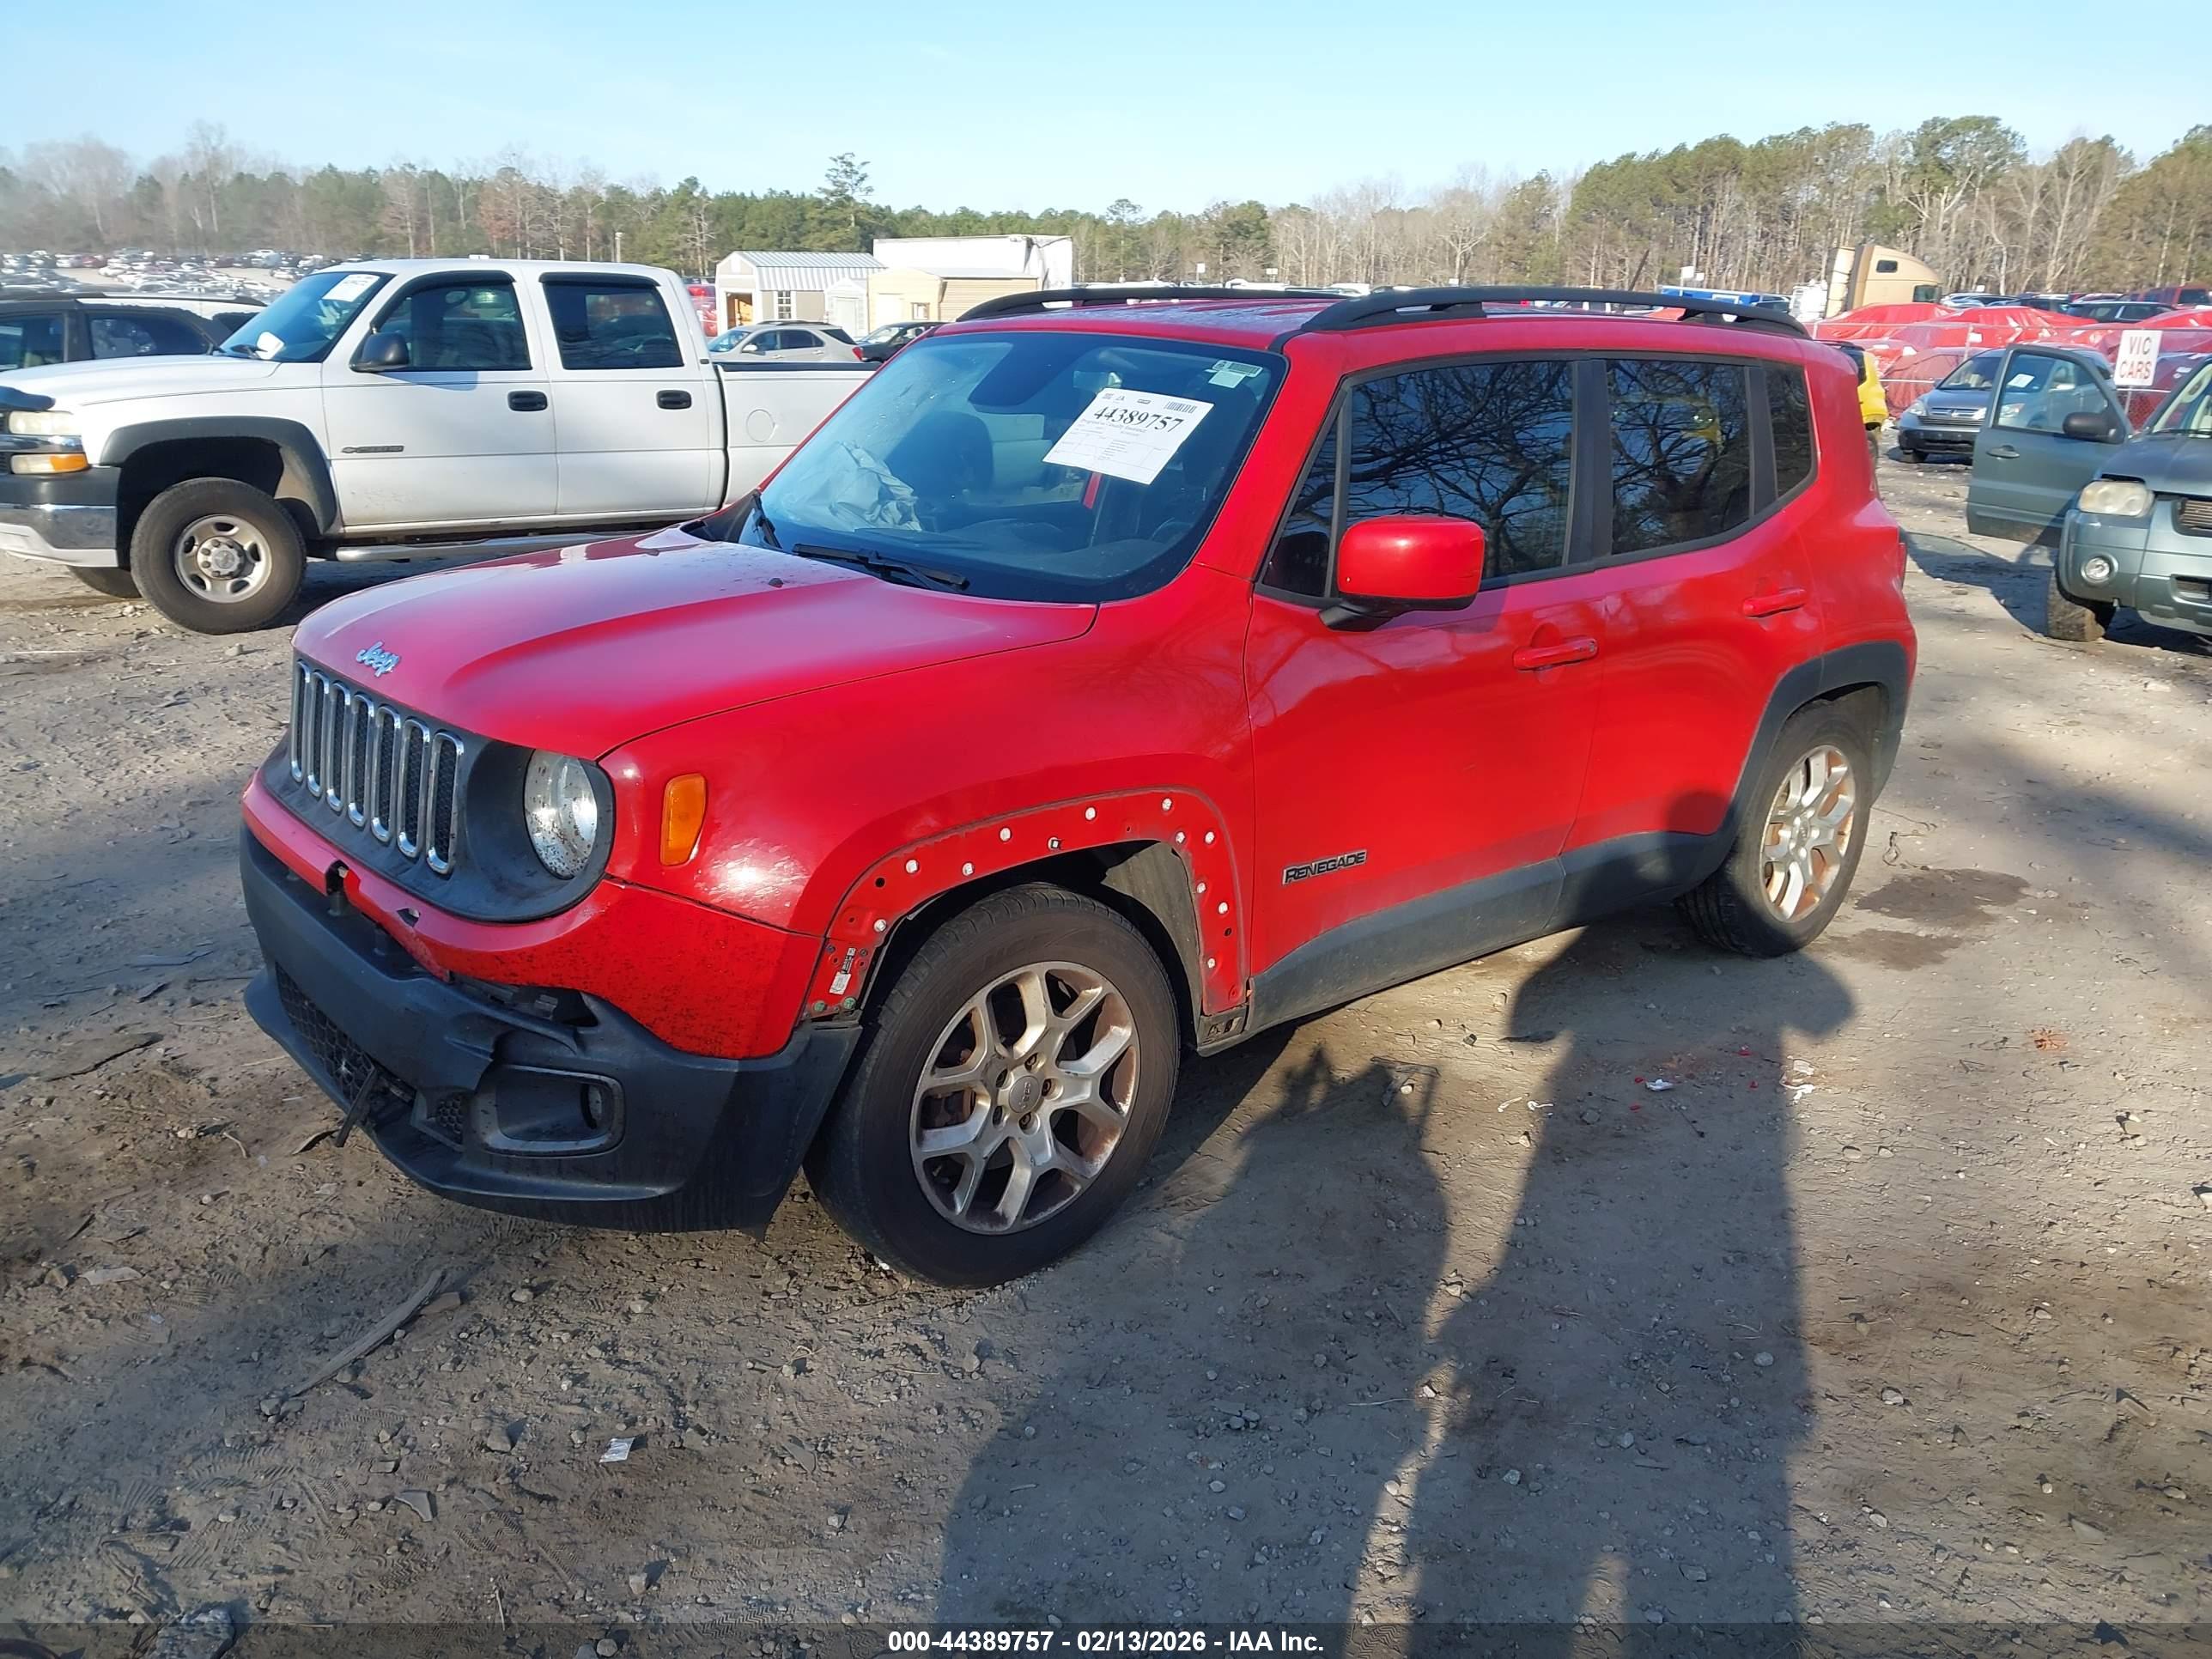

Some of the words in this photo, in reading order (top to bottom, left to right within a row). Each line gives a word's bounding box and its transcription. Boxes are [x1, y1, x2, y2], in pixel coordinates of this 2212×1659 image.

[2129, 336, 2152, 355] VIC
[2119, 361, 2152, 380] CARS
[1093, 406, 1185, 433] 44389757
[356, 641, 399, 678] Jeep
[1283, 849, 1367, 885] RENEGADE
